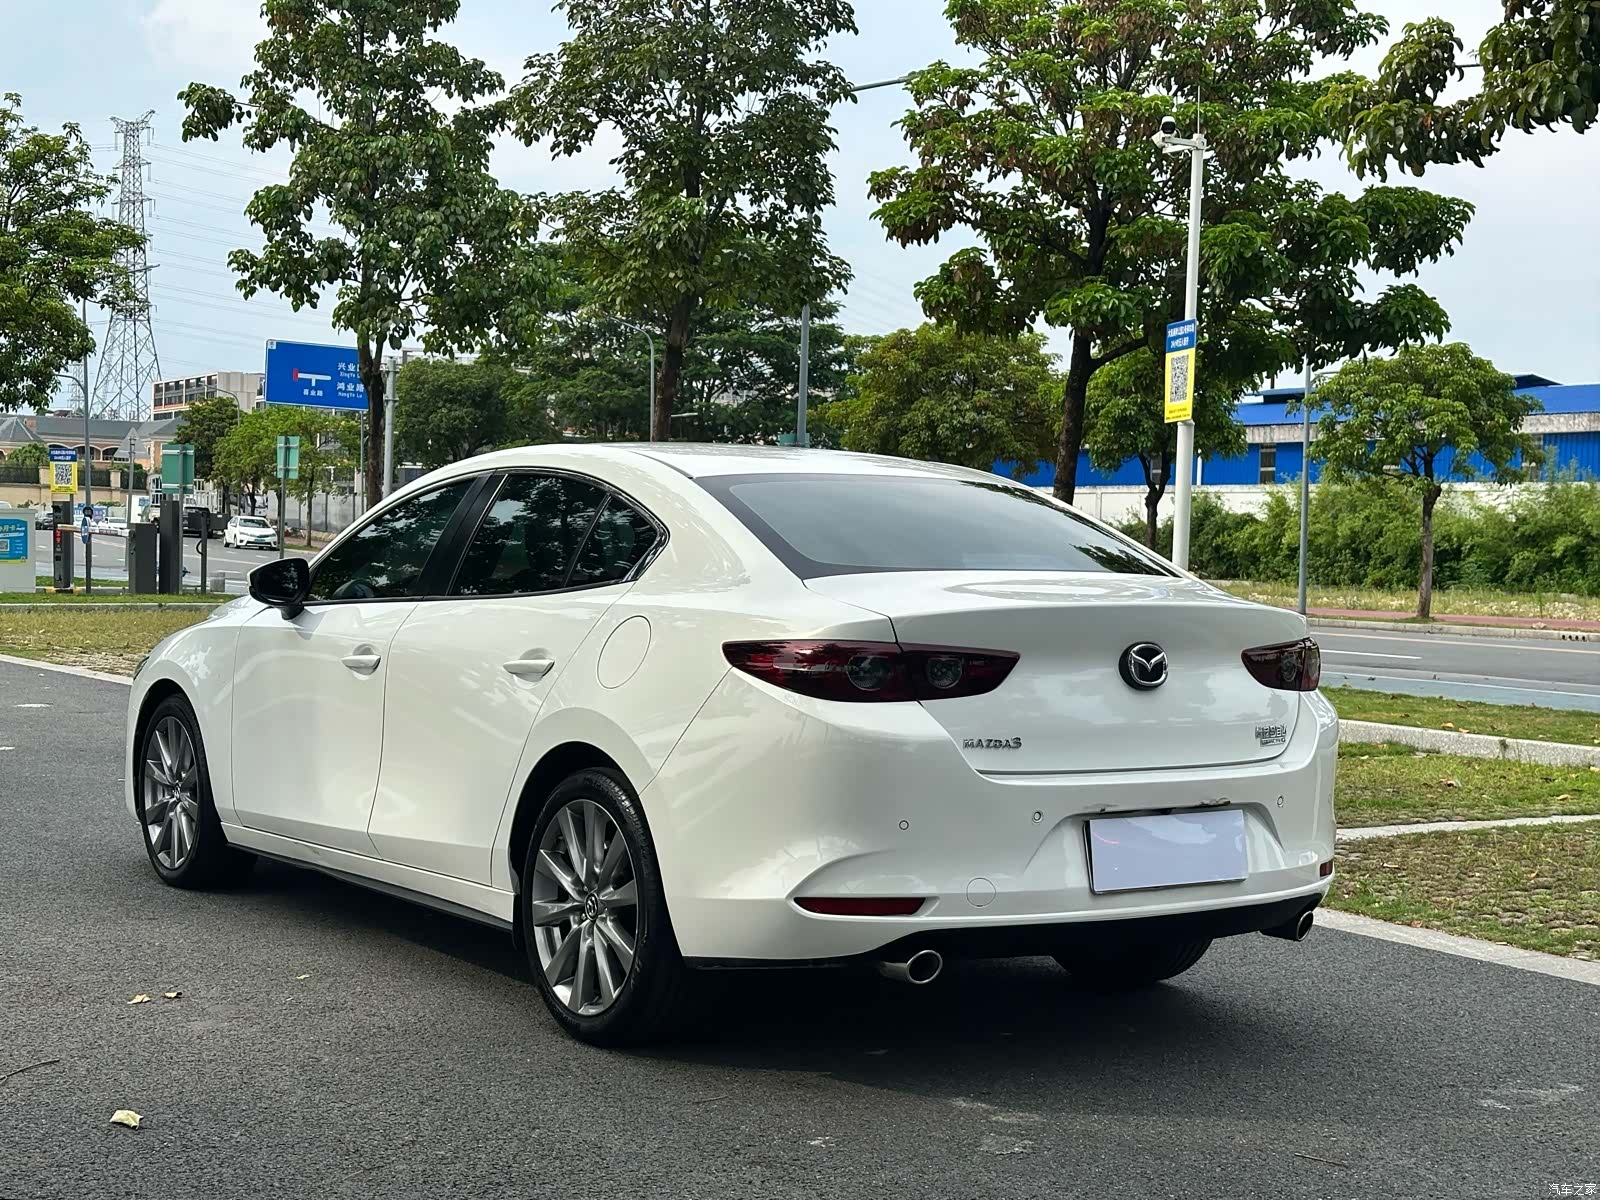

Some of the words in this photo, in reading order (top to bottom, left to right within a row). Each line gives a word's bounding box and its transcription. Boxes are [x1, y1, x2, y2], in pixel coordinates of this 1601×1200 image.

[336, 381, 365, 393] 鸿业路
[962, 736, 1023, 750] MAZDA3
